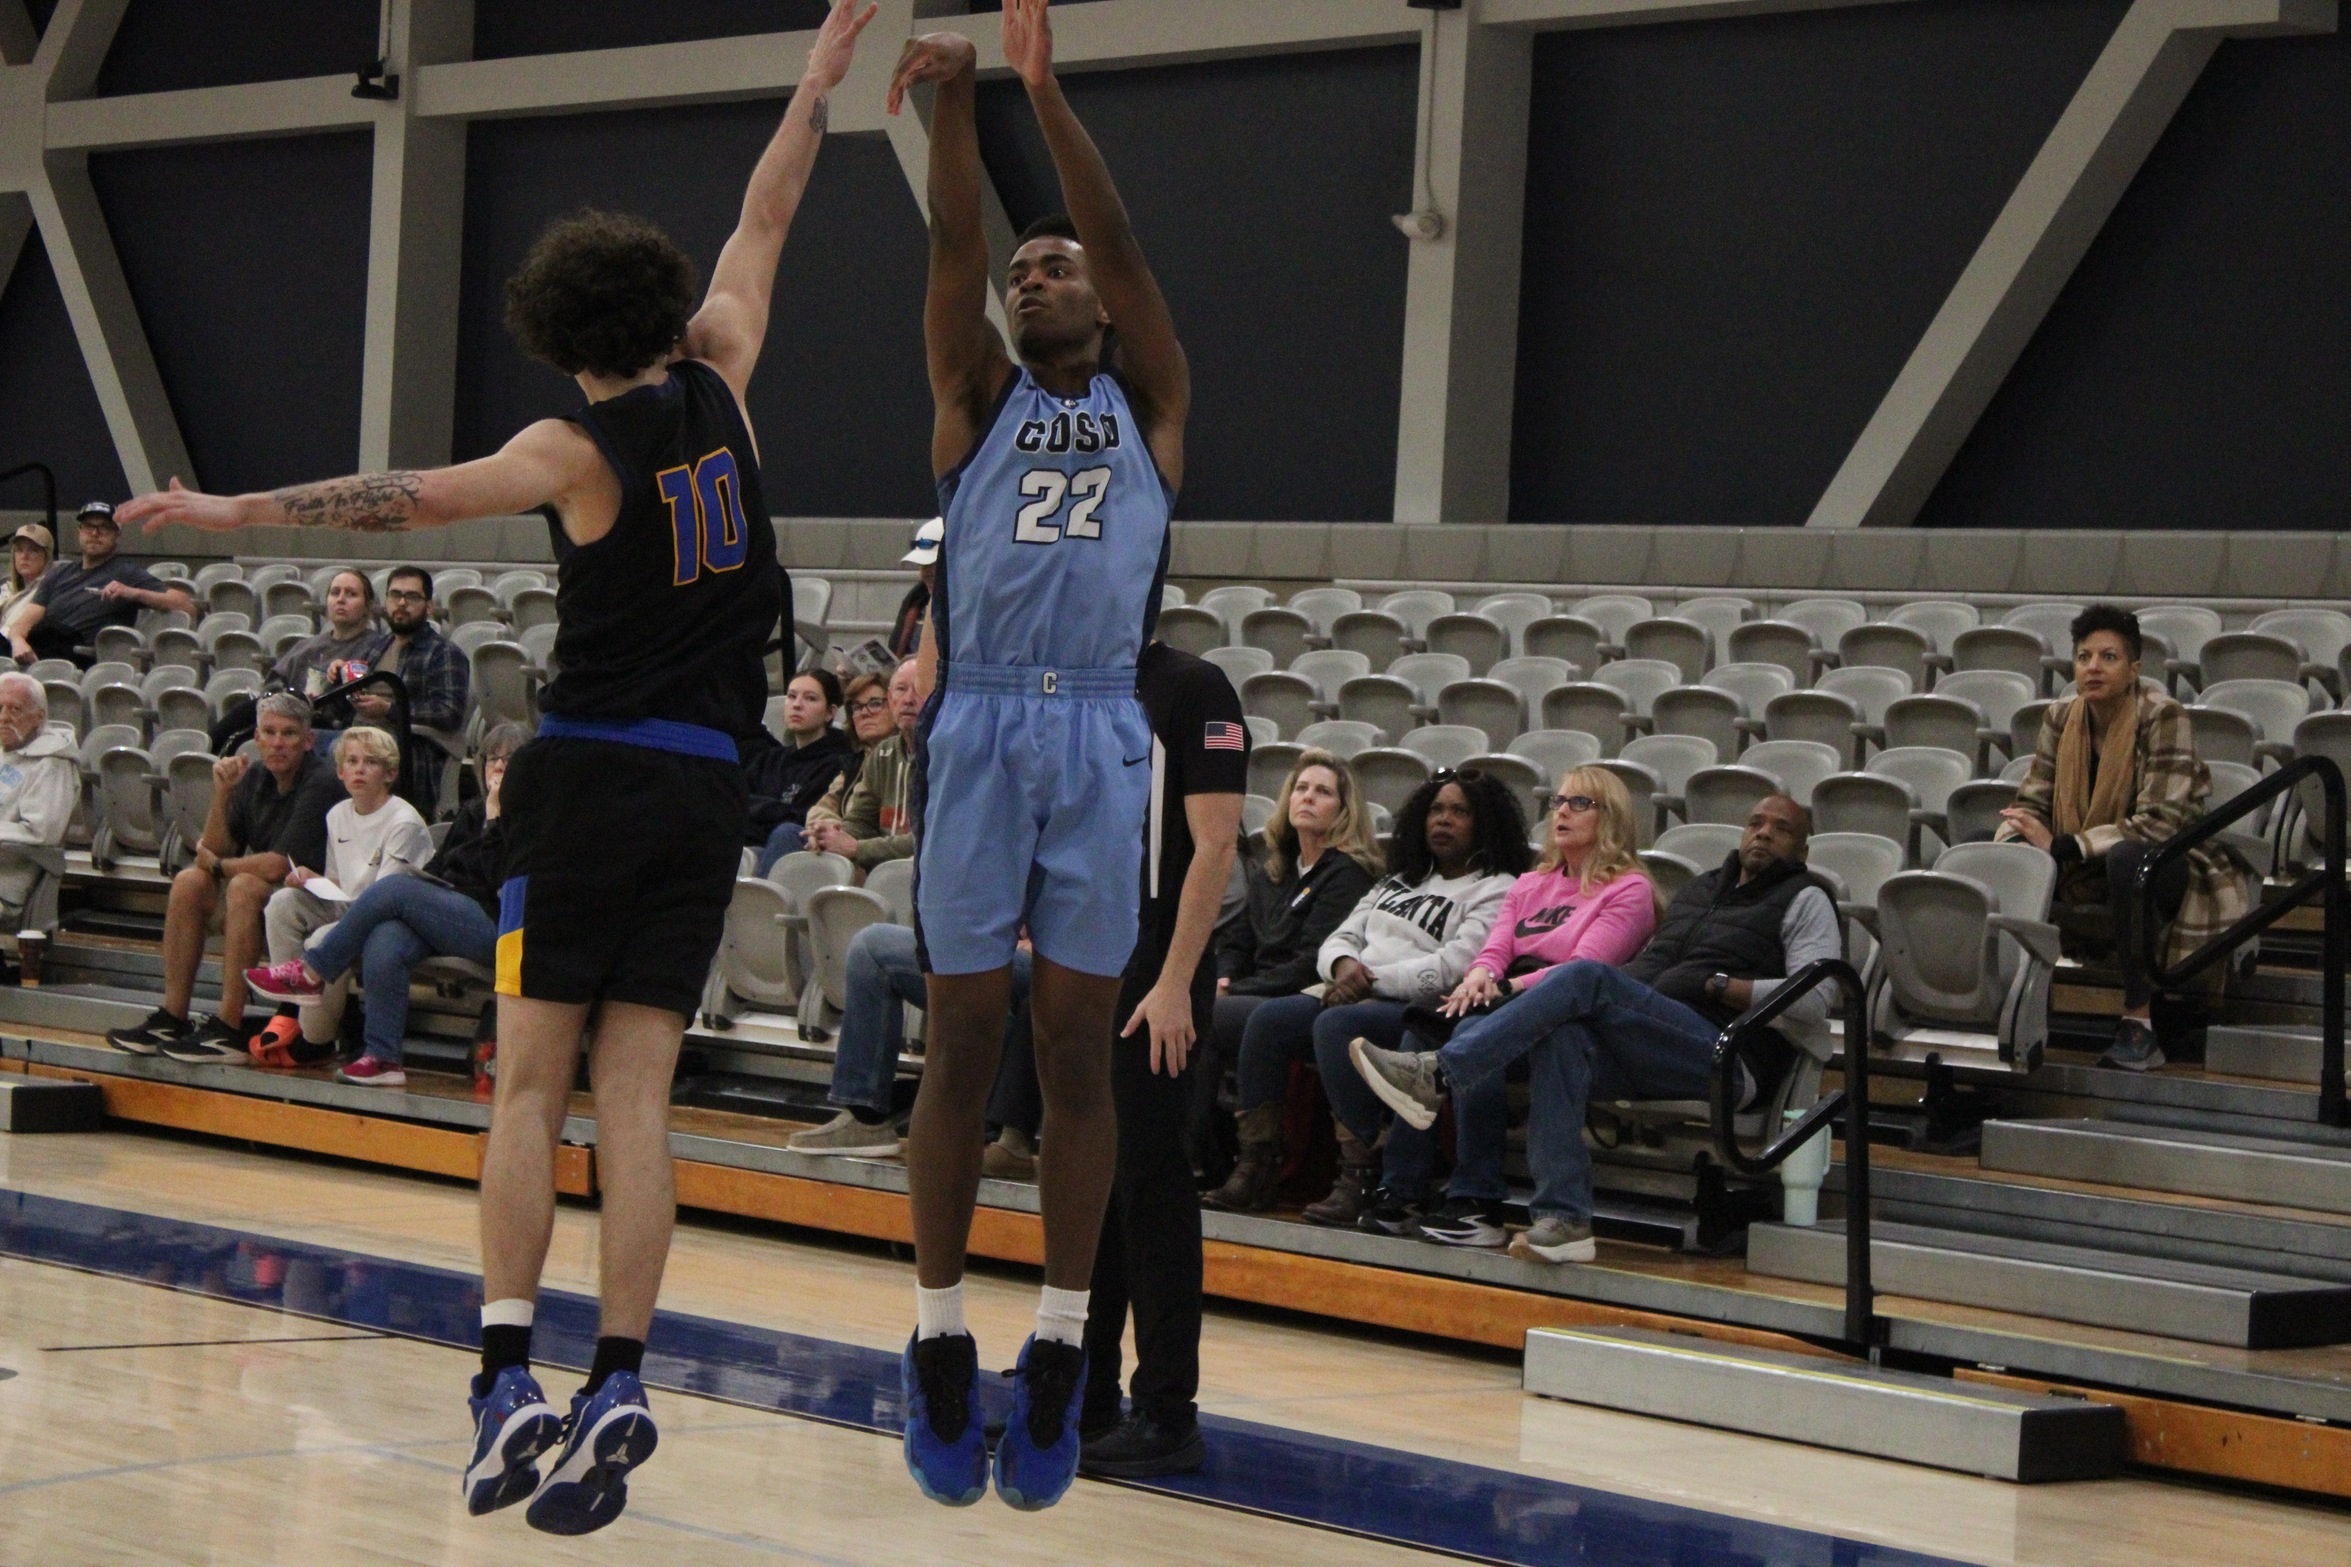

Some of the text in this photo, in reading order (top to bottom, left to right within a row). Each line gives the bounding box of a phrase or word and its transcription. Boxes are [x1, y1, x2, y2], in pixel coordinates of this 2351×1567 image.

[1014, 411, 1121, 454] COSD
[655, 446, 748, 586] 10
[1012, 464, 1112, 545] 22
[1042, 671, 1058, 695] C
[1371, 879, 1455, 943] TLANTA
